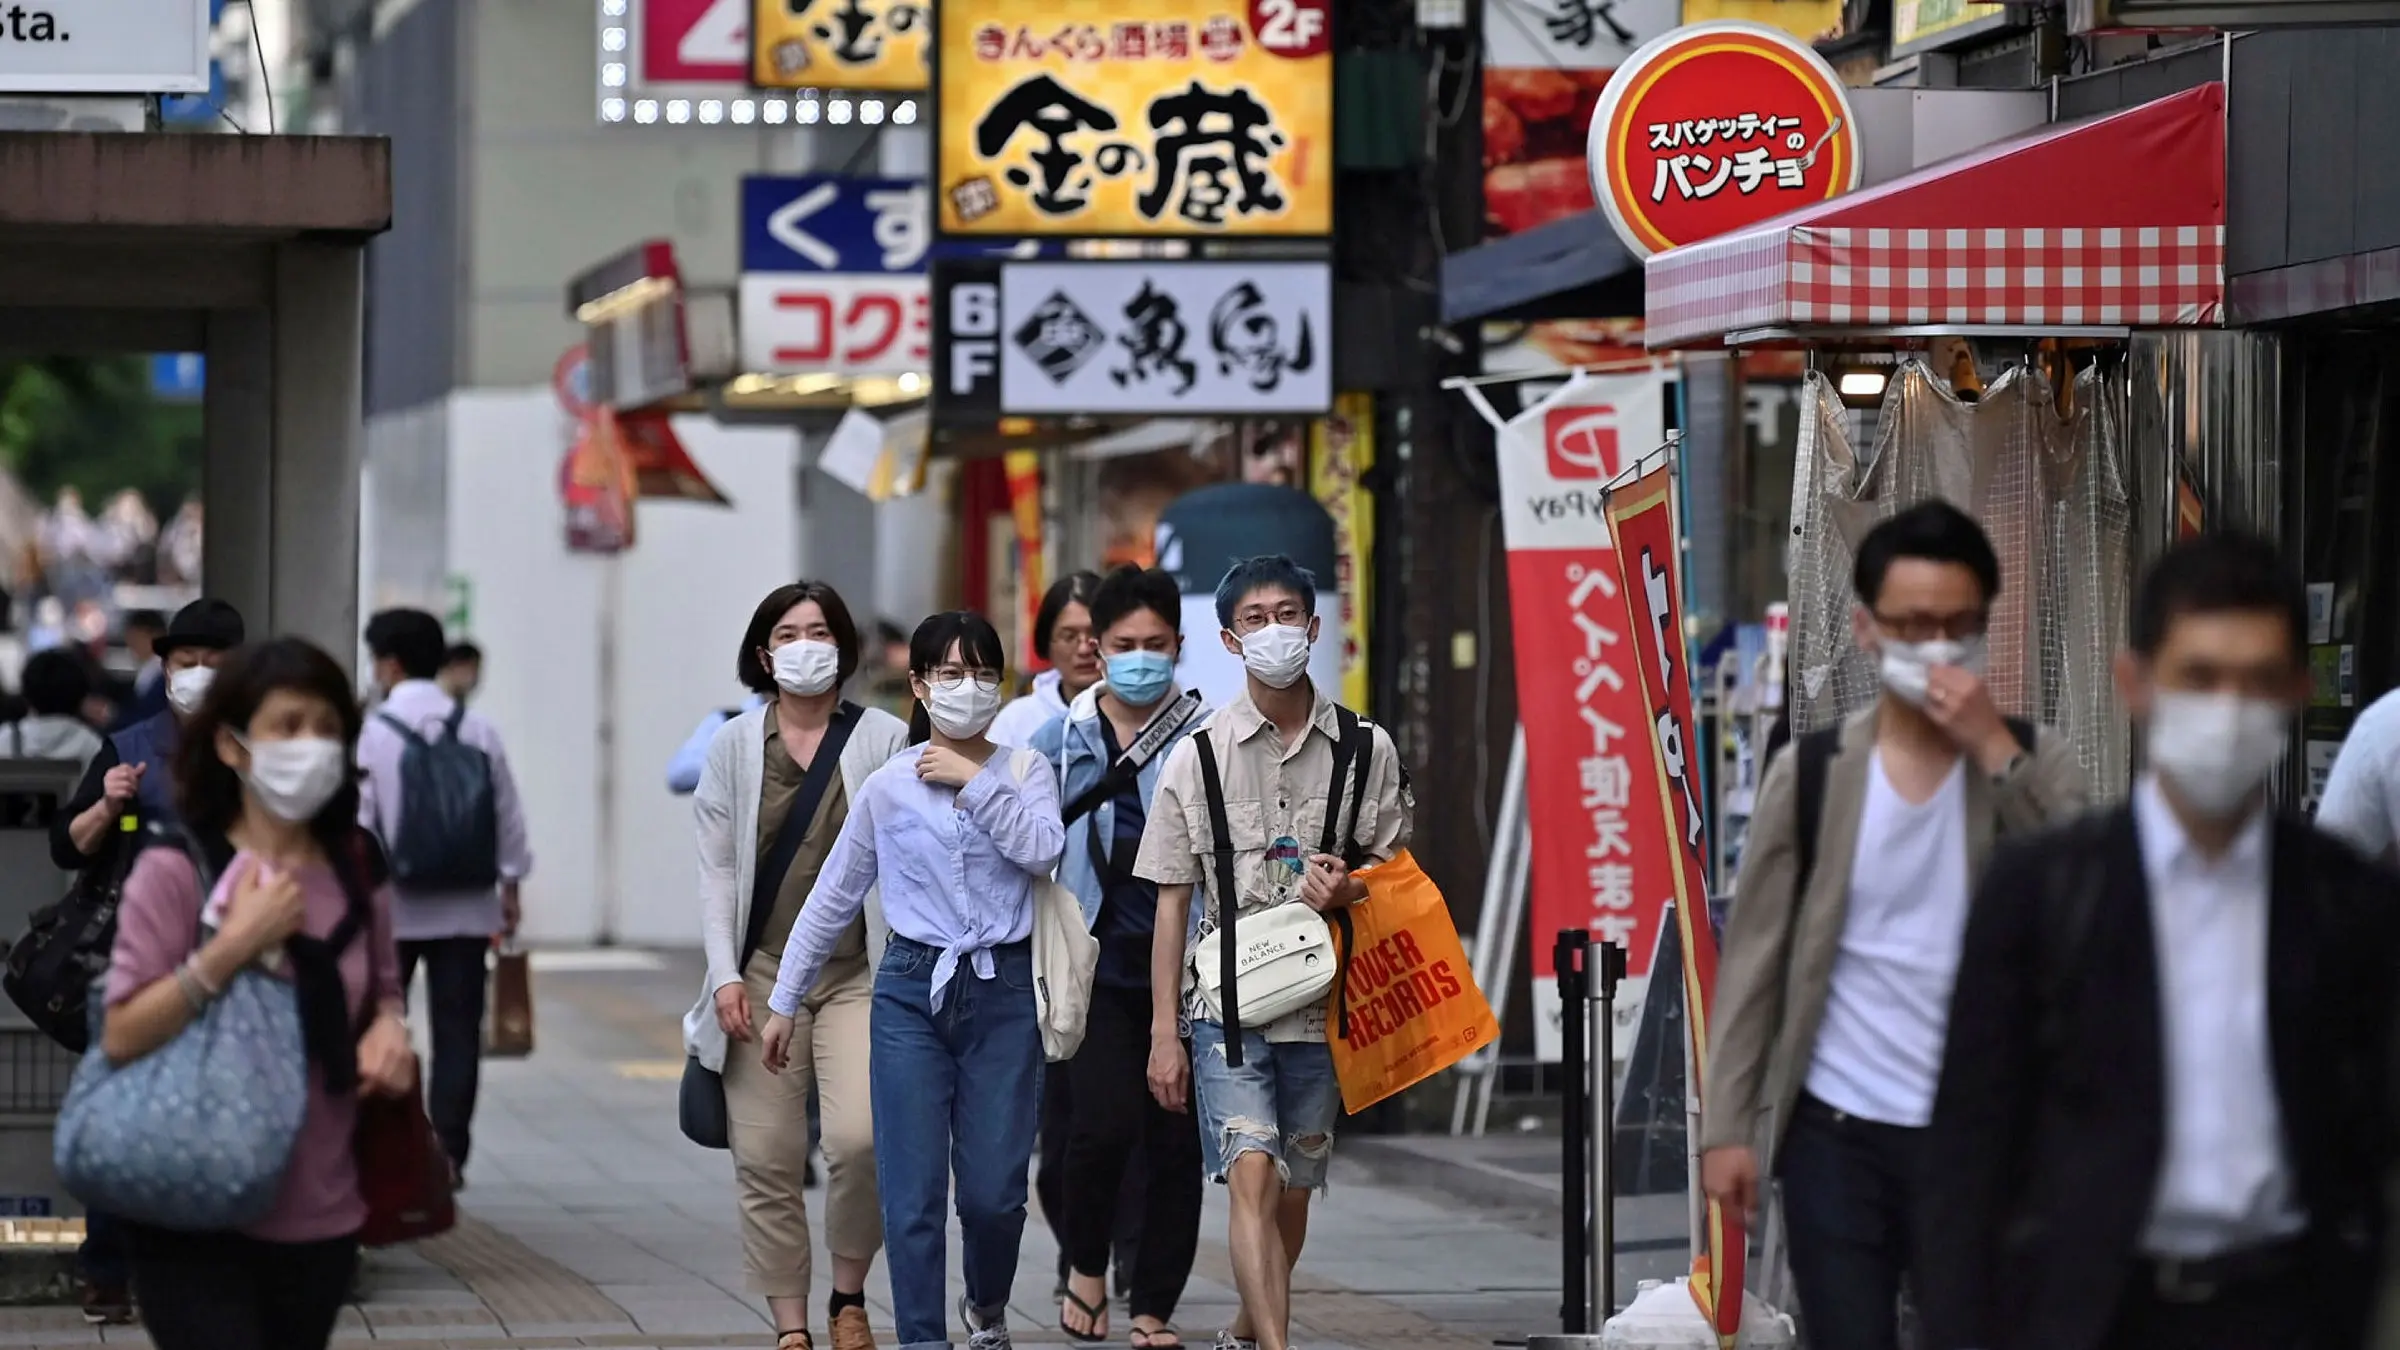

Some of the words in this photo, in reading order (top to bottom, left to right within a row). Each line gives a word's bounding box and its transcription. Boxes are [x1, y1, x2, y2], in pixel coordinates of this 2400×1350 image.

[0, 2, 69, 42] ta.
[977, 23, 1191, 60] きんくら酒場
[1257, 0, 1324, 48] 2F
[977, 75, 1286, 224] 金の蔵
[1651, 146, 1805, 203] パンチョ
[1240, 942, 1286, 967] BALANCE
[1248, 939, 1270, 953] NEW
[1347, 959, 1462, 1051] RECORDS
